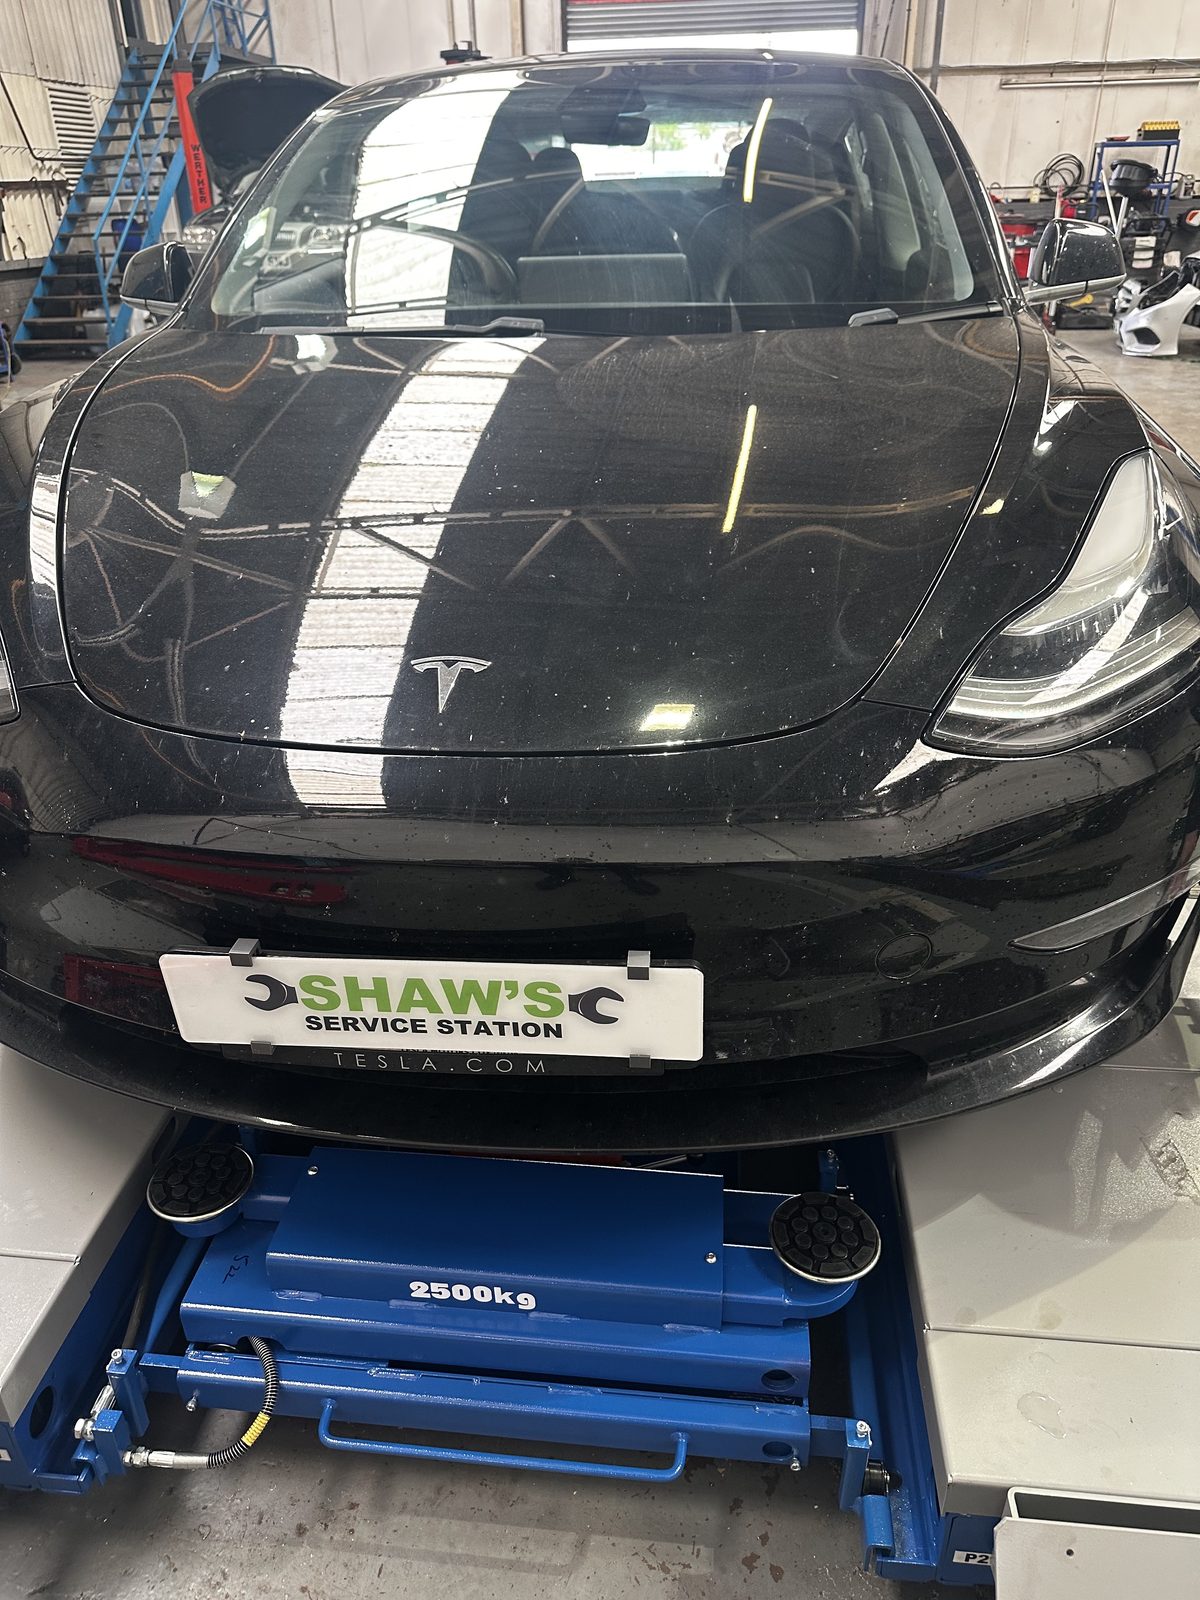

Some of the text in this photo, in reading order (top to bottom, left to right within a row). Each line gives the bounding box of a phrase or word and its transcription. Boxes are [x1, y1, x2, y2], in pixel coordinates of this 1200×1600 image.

[191, 144, 207, 204] WERTHER
[299, 974, 565, 1018] SHAW'S
[305, 1015, 563, 1039] SERVICE STATION
[333, 1052, 545, 1073] TESLA.COM
[409, 1281, 536, 1310] 2500kg
[964, 1552, 990, 1564] P2
